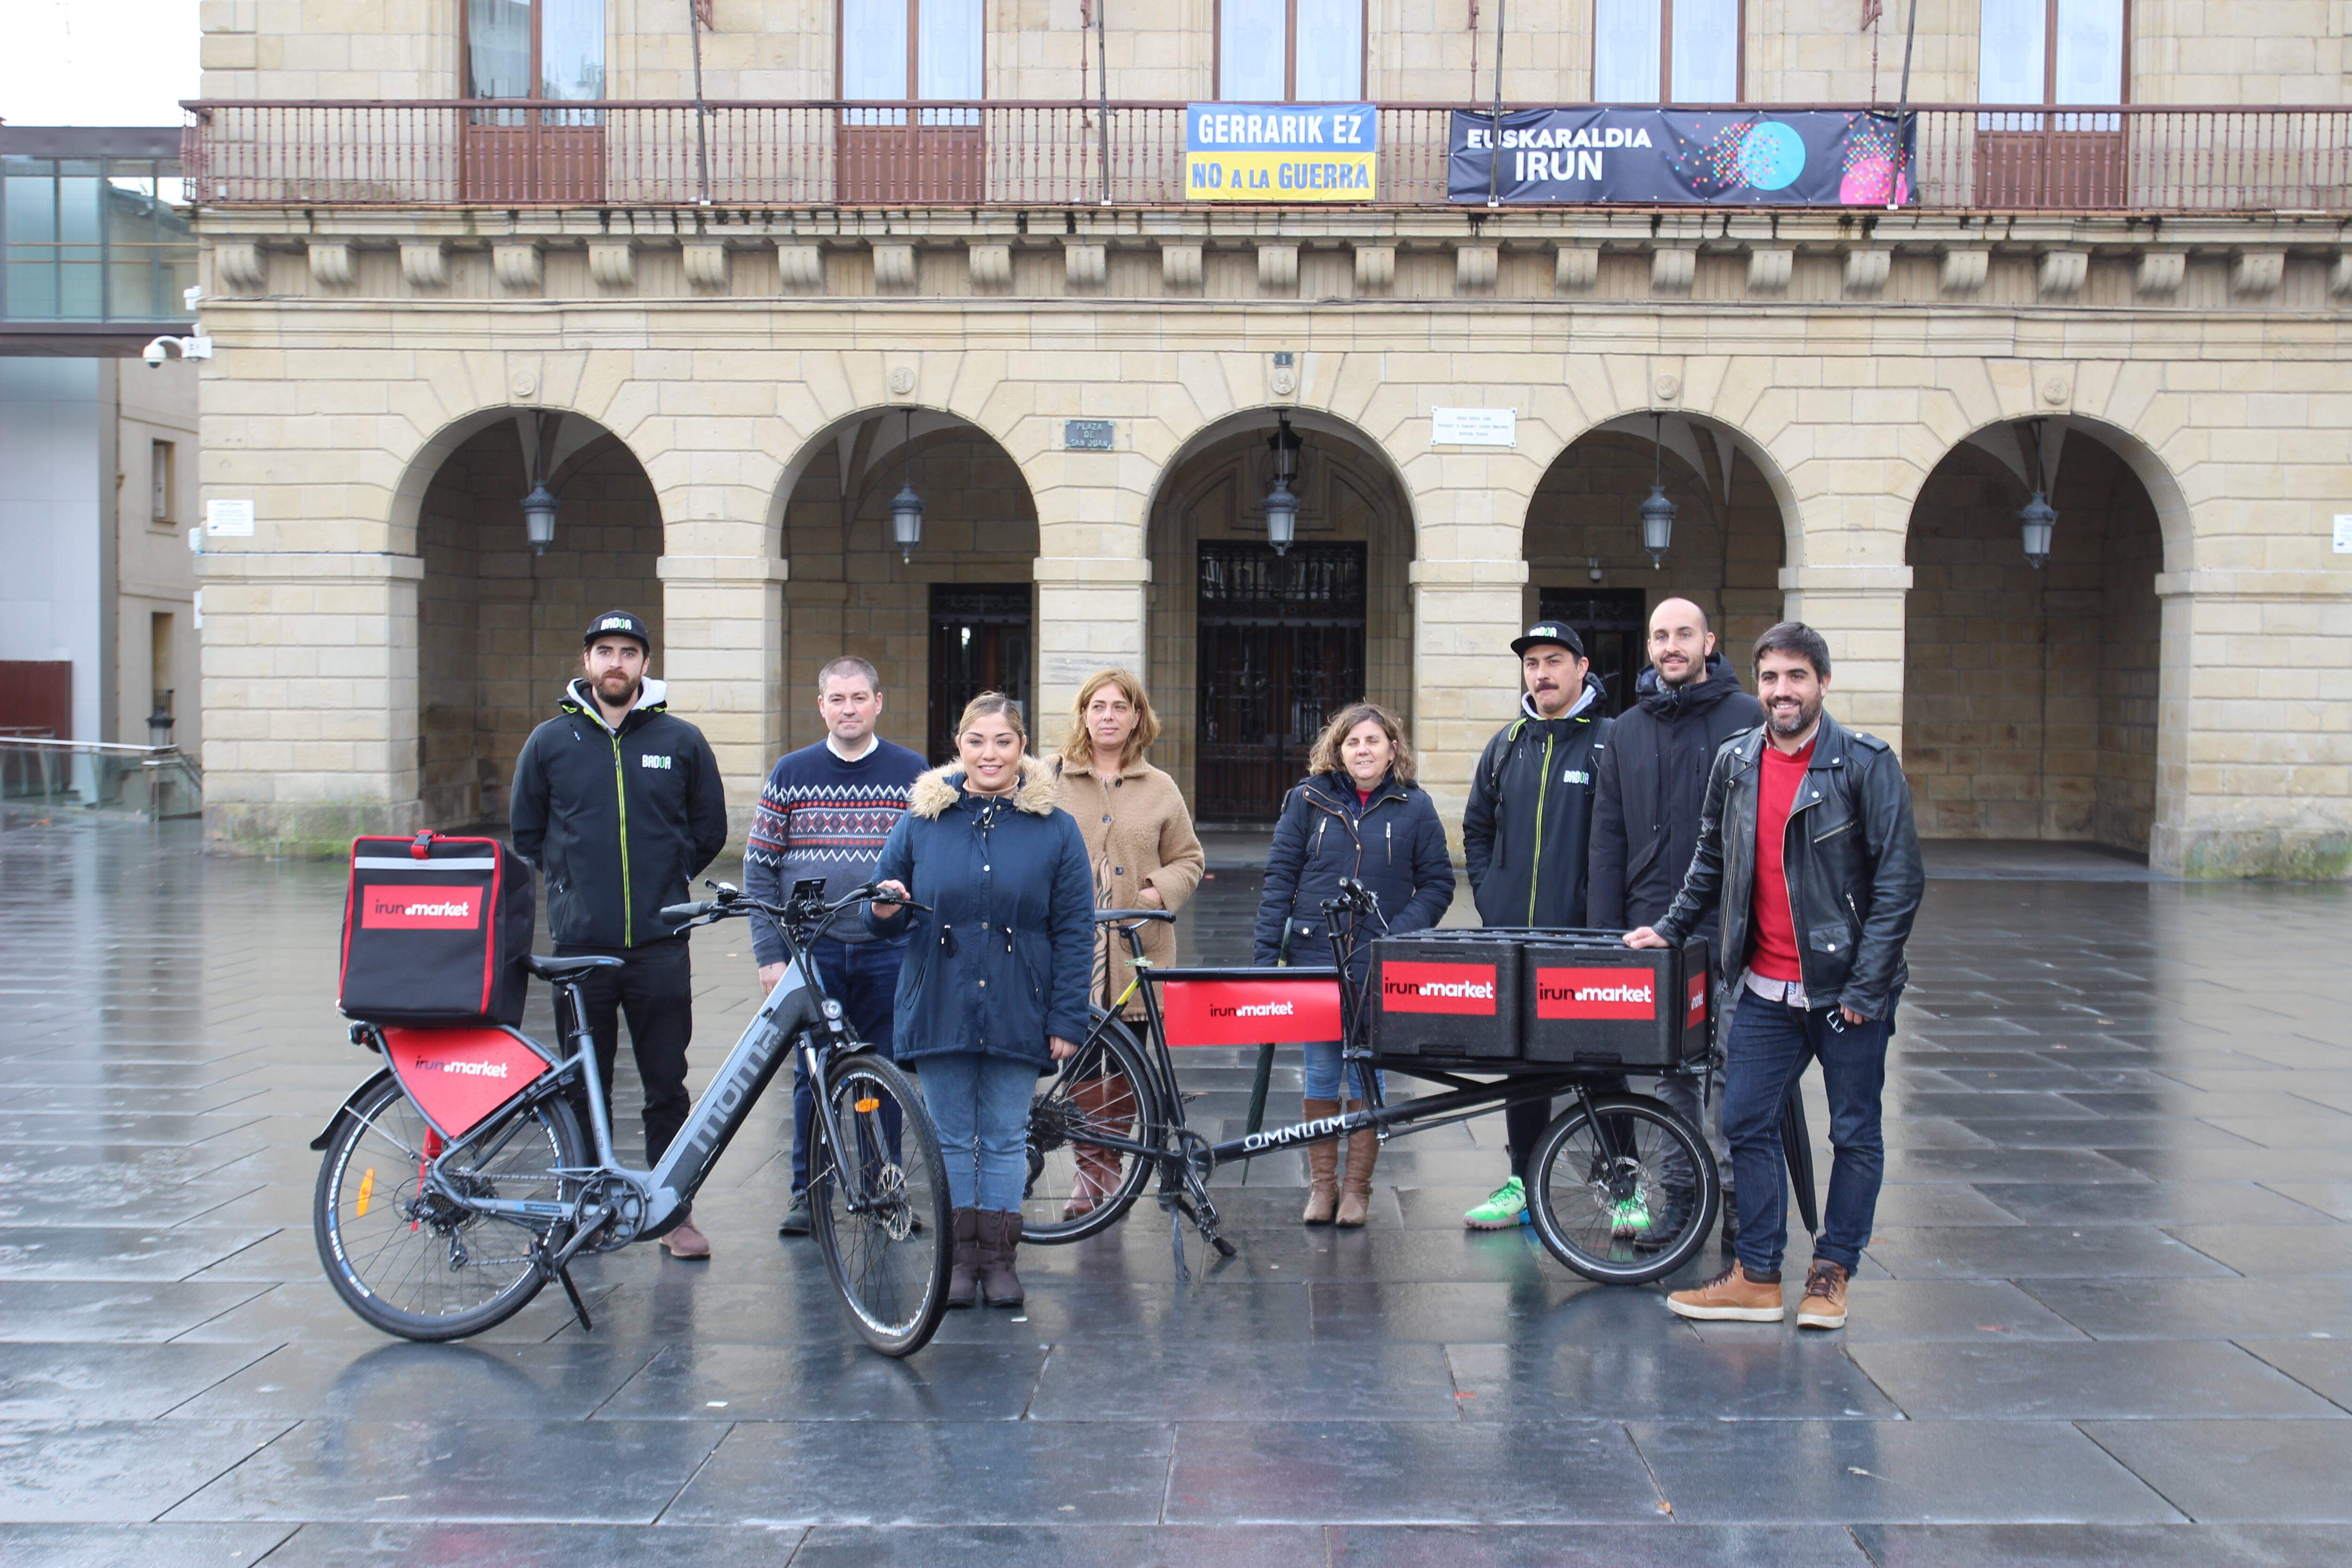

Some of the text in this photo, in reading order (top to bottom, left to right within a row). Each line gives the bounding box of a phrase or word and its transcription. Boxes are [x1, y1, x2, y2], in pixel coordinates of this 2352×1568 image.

[1198, 113, 1362, 144] GERRARIK EZ
[1467, 128, 1653, 149] EUSKARALDIA
[1192, 163, 1370, 189] NO A LA GUERRA
[1515, 150, 1603, 182] IRUN
[375, 899, 469, 917] irun.market
[1384, 977, 1494, 1000] irun.market
[1539, 983, 1652, 1003] irun.market
[1210, 1001, 1294, 1017] irun.market
[415, 1055, 508, 1078] irun.market
[1243, 1114, 1352, 1152] OMNIUM
